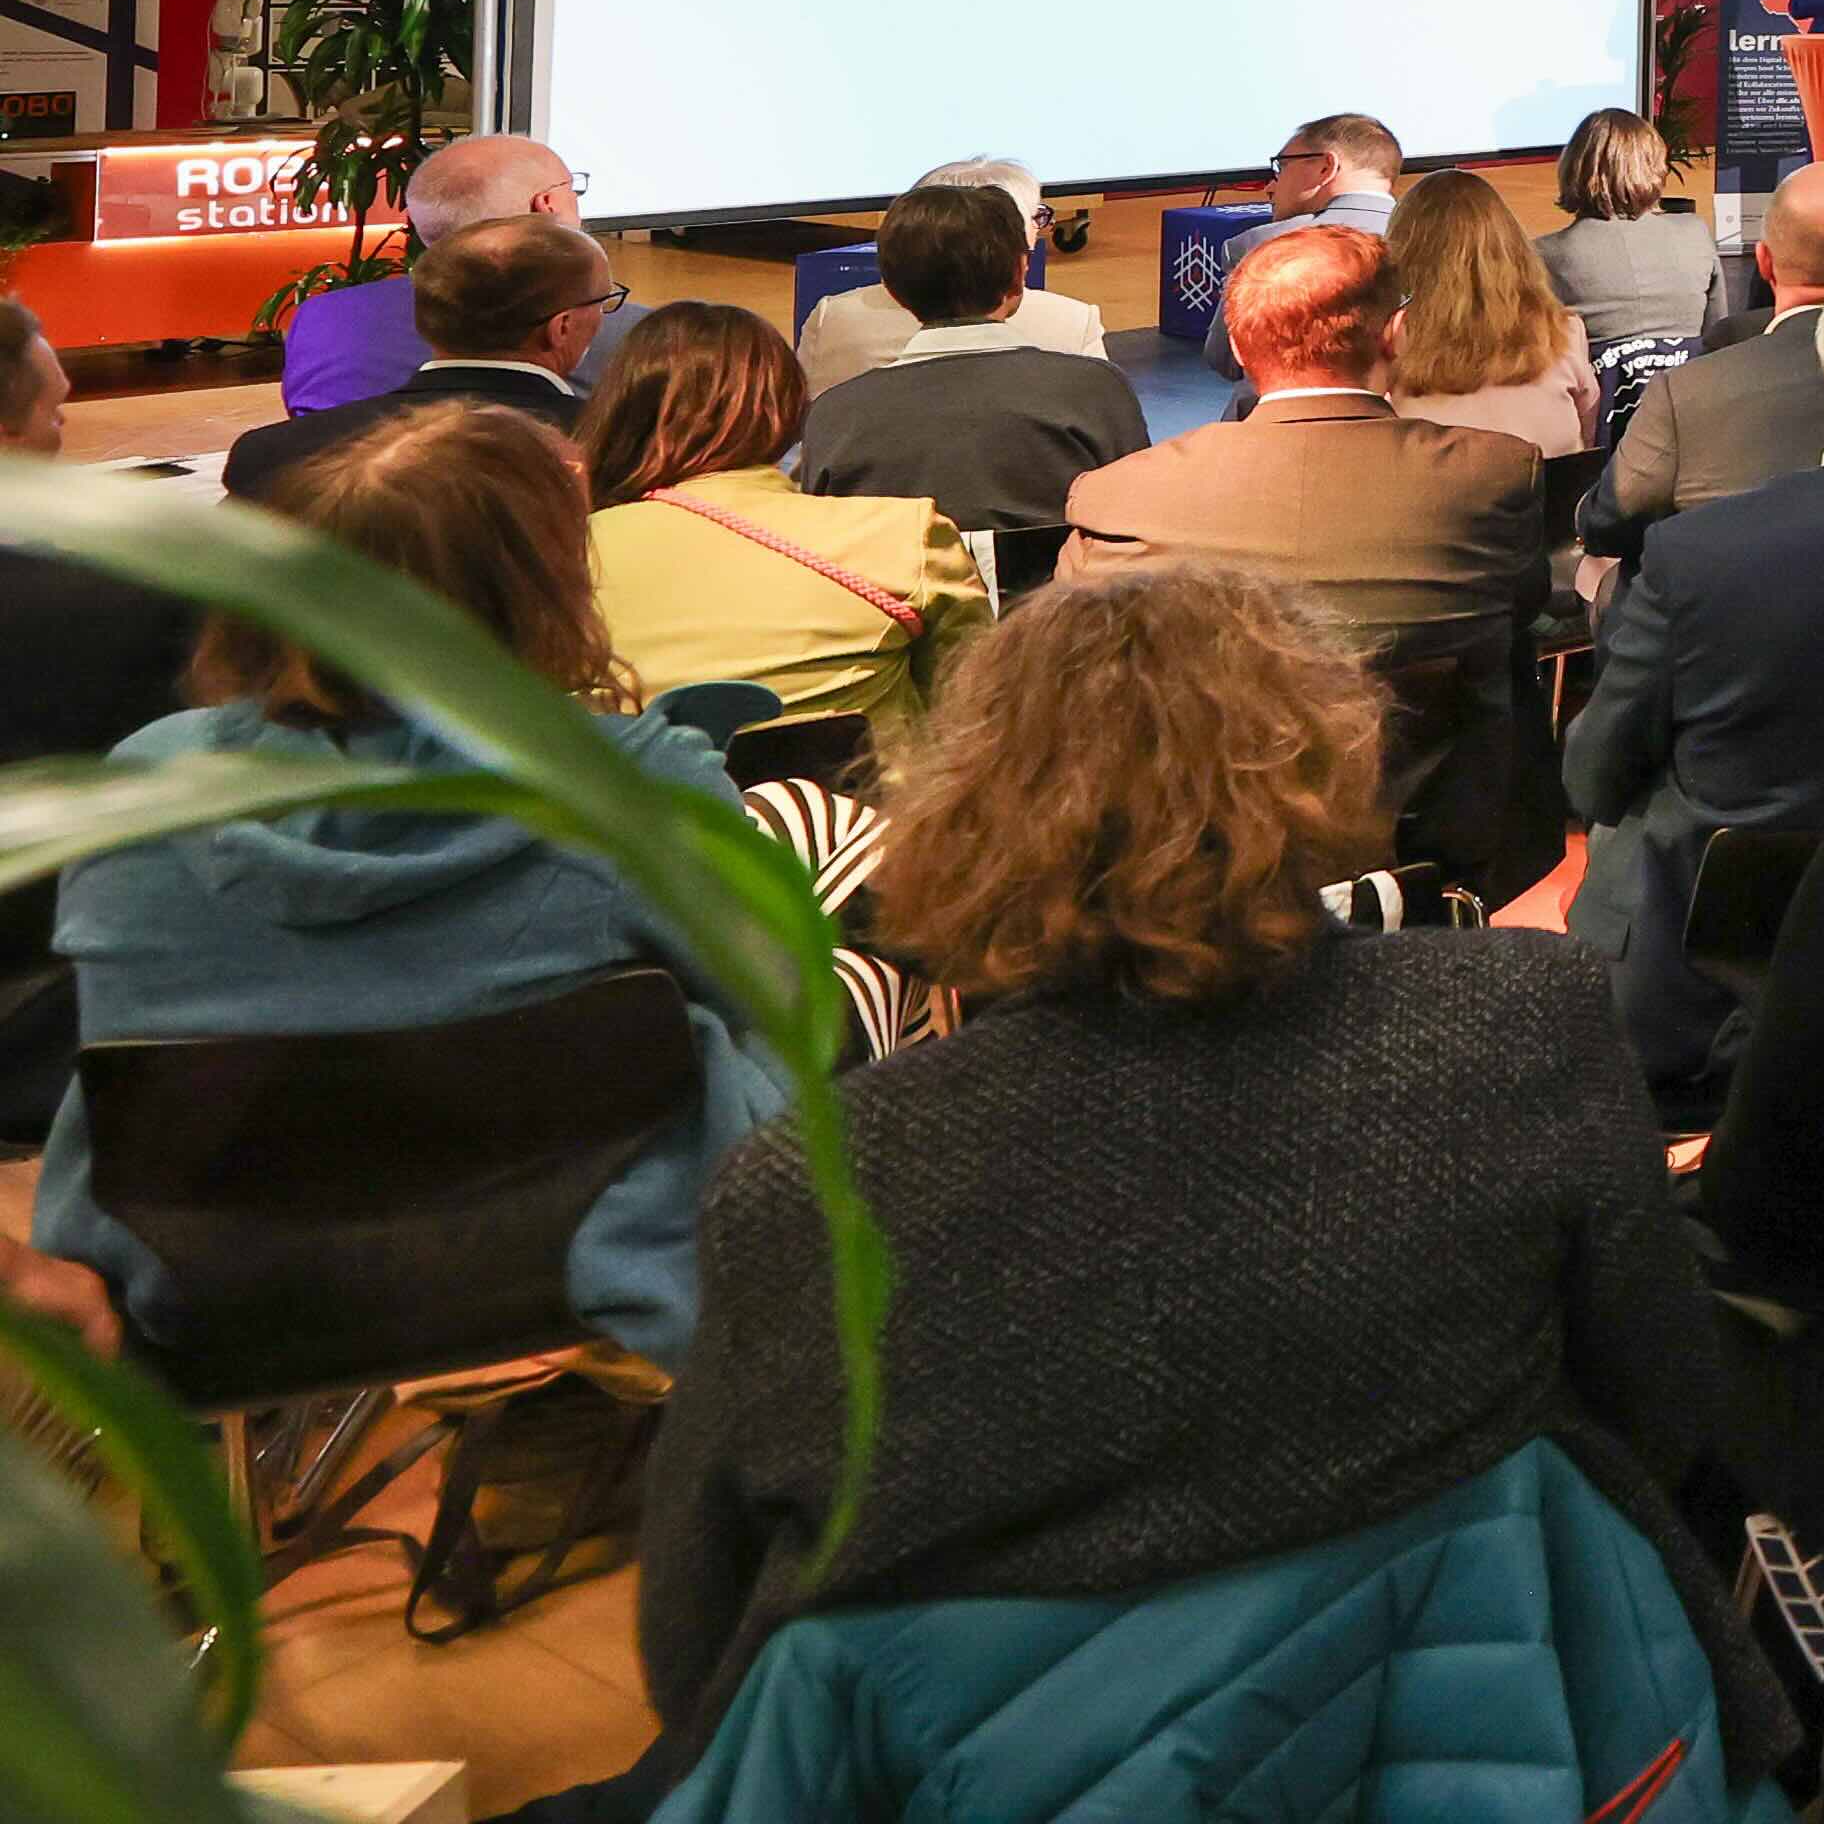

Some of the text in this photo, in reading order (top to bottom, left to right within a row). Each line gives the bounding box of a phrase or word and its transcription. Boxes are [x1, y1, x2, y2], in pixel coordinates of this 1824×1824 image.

[1729, 29, 1784, 51] lern
[2, 95, 73, 117] OBO
[175, 156, 330, 197] ROB
[175, 196, 348, 231] station
